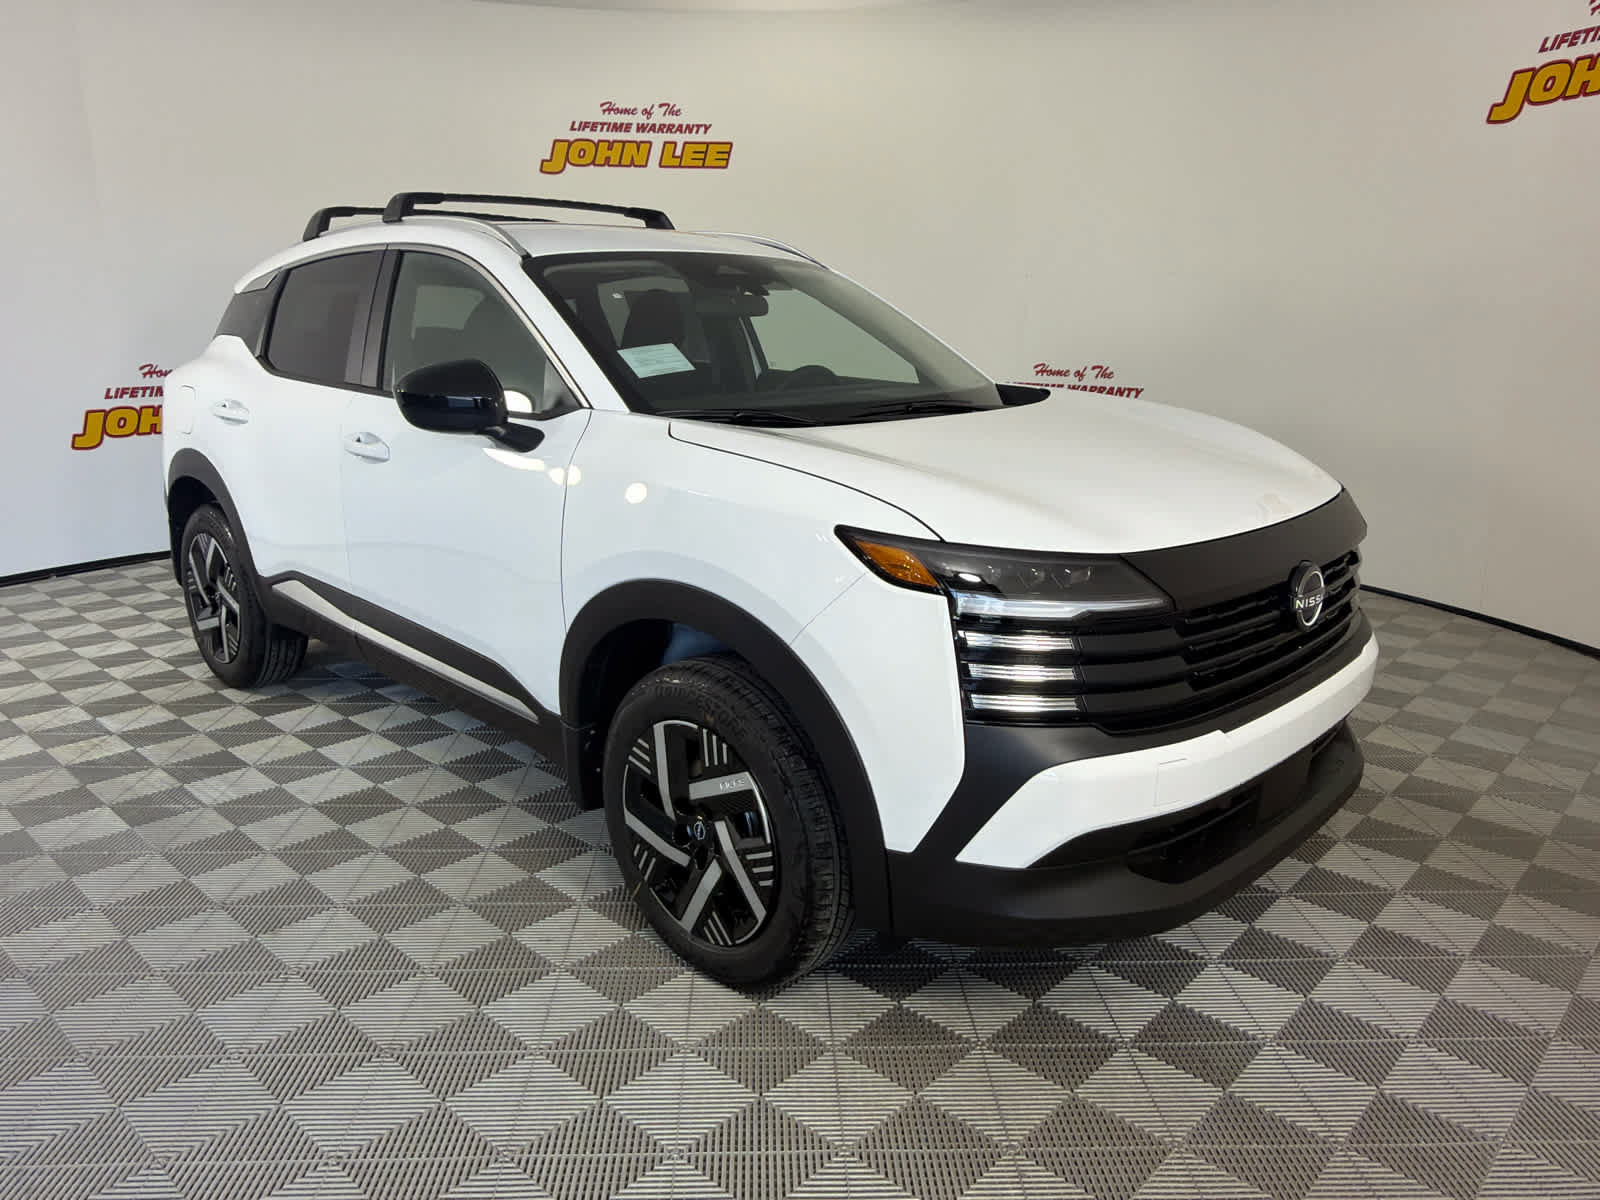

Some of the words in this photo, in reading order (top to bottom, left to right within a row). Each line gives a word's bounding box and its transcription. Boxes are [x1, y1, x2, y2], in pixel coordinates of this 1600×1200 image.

[1538, 25, 1600, 53] LIFETI
[600, 101, 637, 116] Home
[641, 103, 654, 119] of
[658, 102, 682, 117] The
[569, 120, 633, 133] LIFETIME
[636, 122, 712, 135] WARRANTY
[539, 138, 653, 175] JOHN
[658, 140, 733, 170] LEE
[1033, 362, 1071, 377] Home
[1073, 366, 1088, 382] of
[1091, 365, 1115, 379] The
[1295, 594, 1321, 609] NISS
